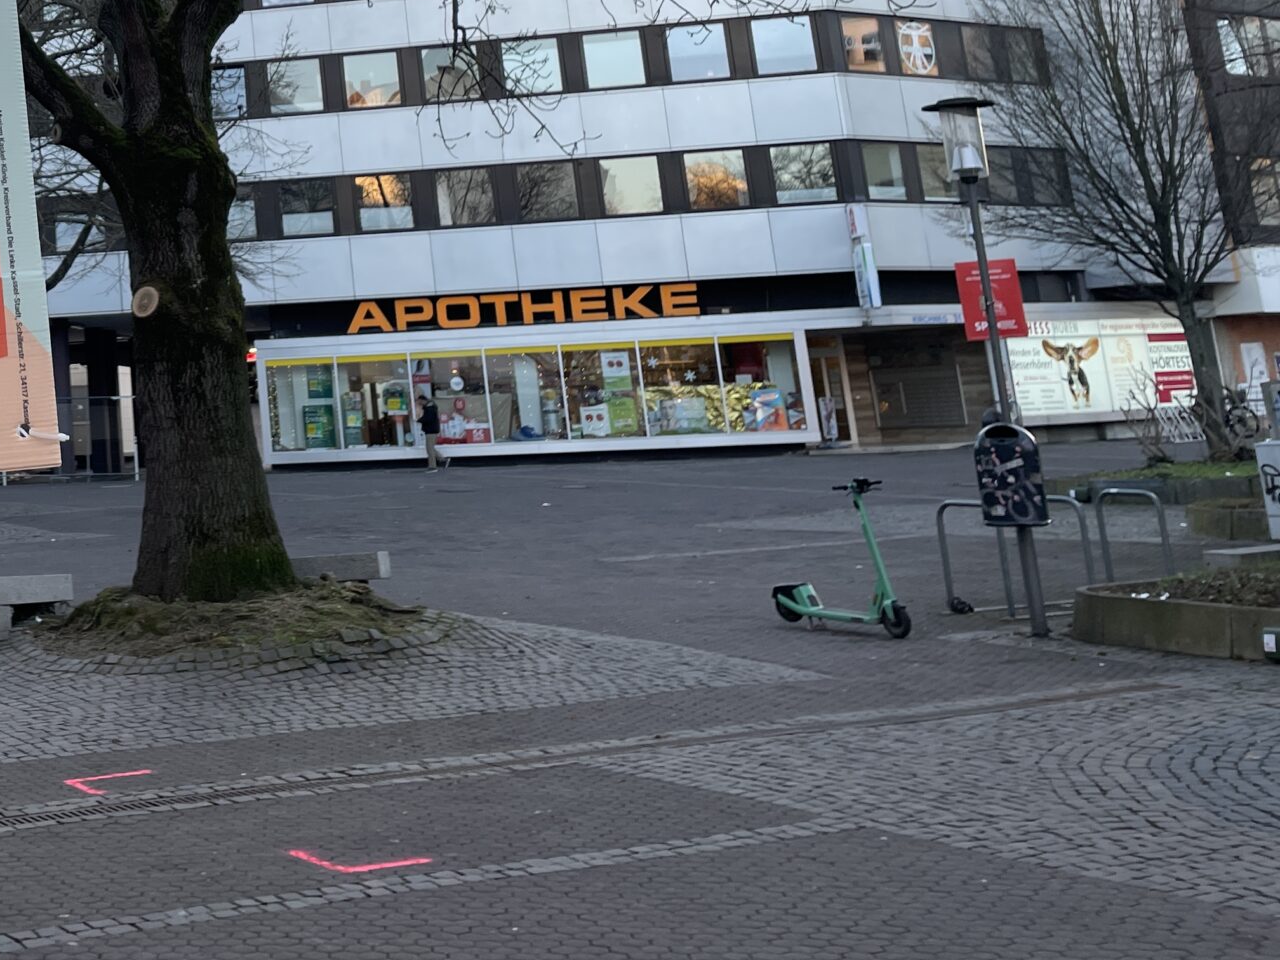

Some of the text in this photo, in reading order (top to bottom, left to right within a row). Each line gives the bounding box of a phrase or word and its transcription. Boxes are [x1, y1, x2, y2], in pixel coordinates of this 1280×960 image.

[2, 187, 13, 234] Kreisverband
[6, 235, 15, 248] Die
[8, 249, 16, 270] Linke
[347, 282, 701, 334] APOTHEKE
[15, 321, 26, 361] Schillerstr.
[20, 375, 30, 398] 34117
